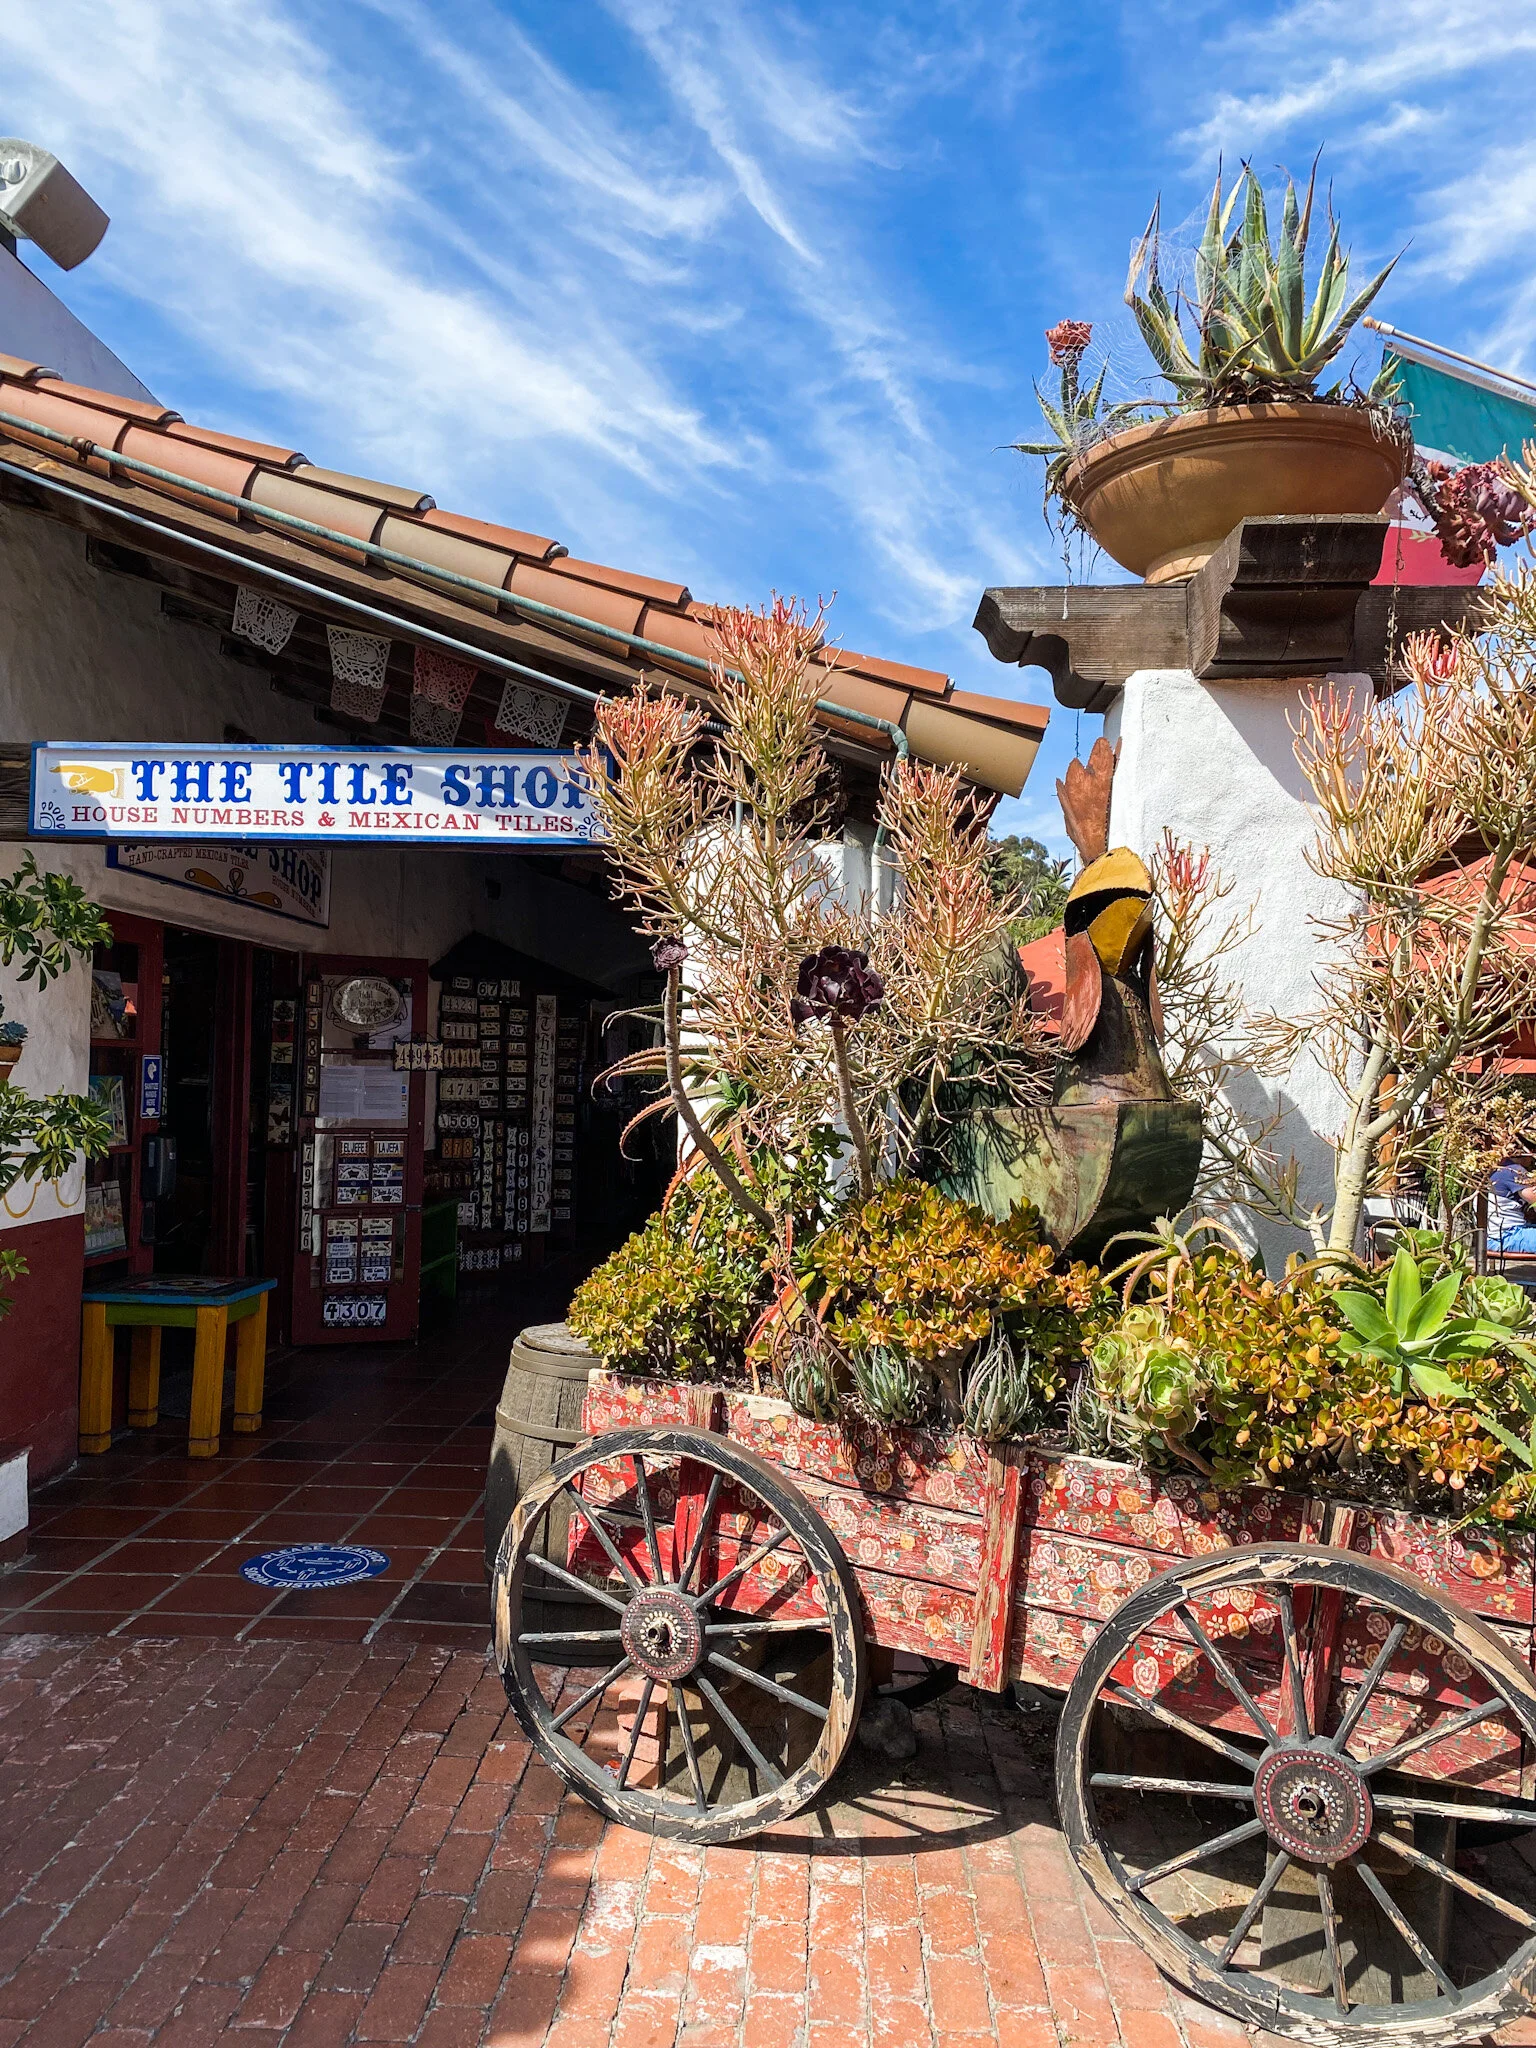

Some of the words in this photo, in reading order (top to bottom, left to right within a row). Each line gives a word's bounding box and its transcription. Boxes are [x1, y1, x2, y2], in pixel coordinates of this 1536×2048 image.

[131, 760, 252, 803] THE
[279, 761, 413, 806] TILE
[71, 806, 158, 823] HOUSE
[170, 807, 304, 827] NUMBERS
[317, 811, 335, 828] &
[348, 811, 482, 831] MEXICAN
[128, 848, 193, 866] HAND-CRAFTED
[195, 848, 228, 864] MEXICAN
[229, 854, 250, 870] TILES
[399, 1048, 439, 1065] 495
[446, 1083, 474, 1096] 474
[351, 1142, 365, 1153] JEFE
[386, 1142, 400, 1153] JEFA
[325, 1302, 385, 1320] 4307
[260, 1545, 324, 1560] PLEASE
[244, 1566, 273, 1586] SOCIAL
[273, 1572, 374, 1588] DISTANCING
